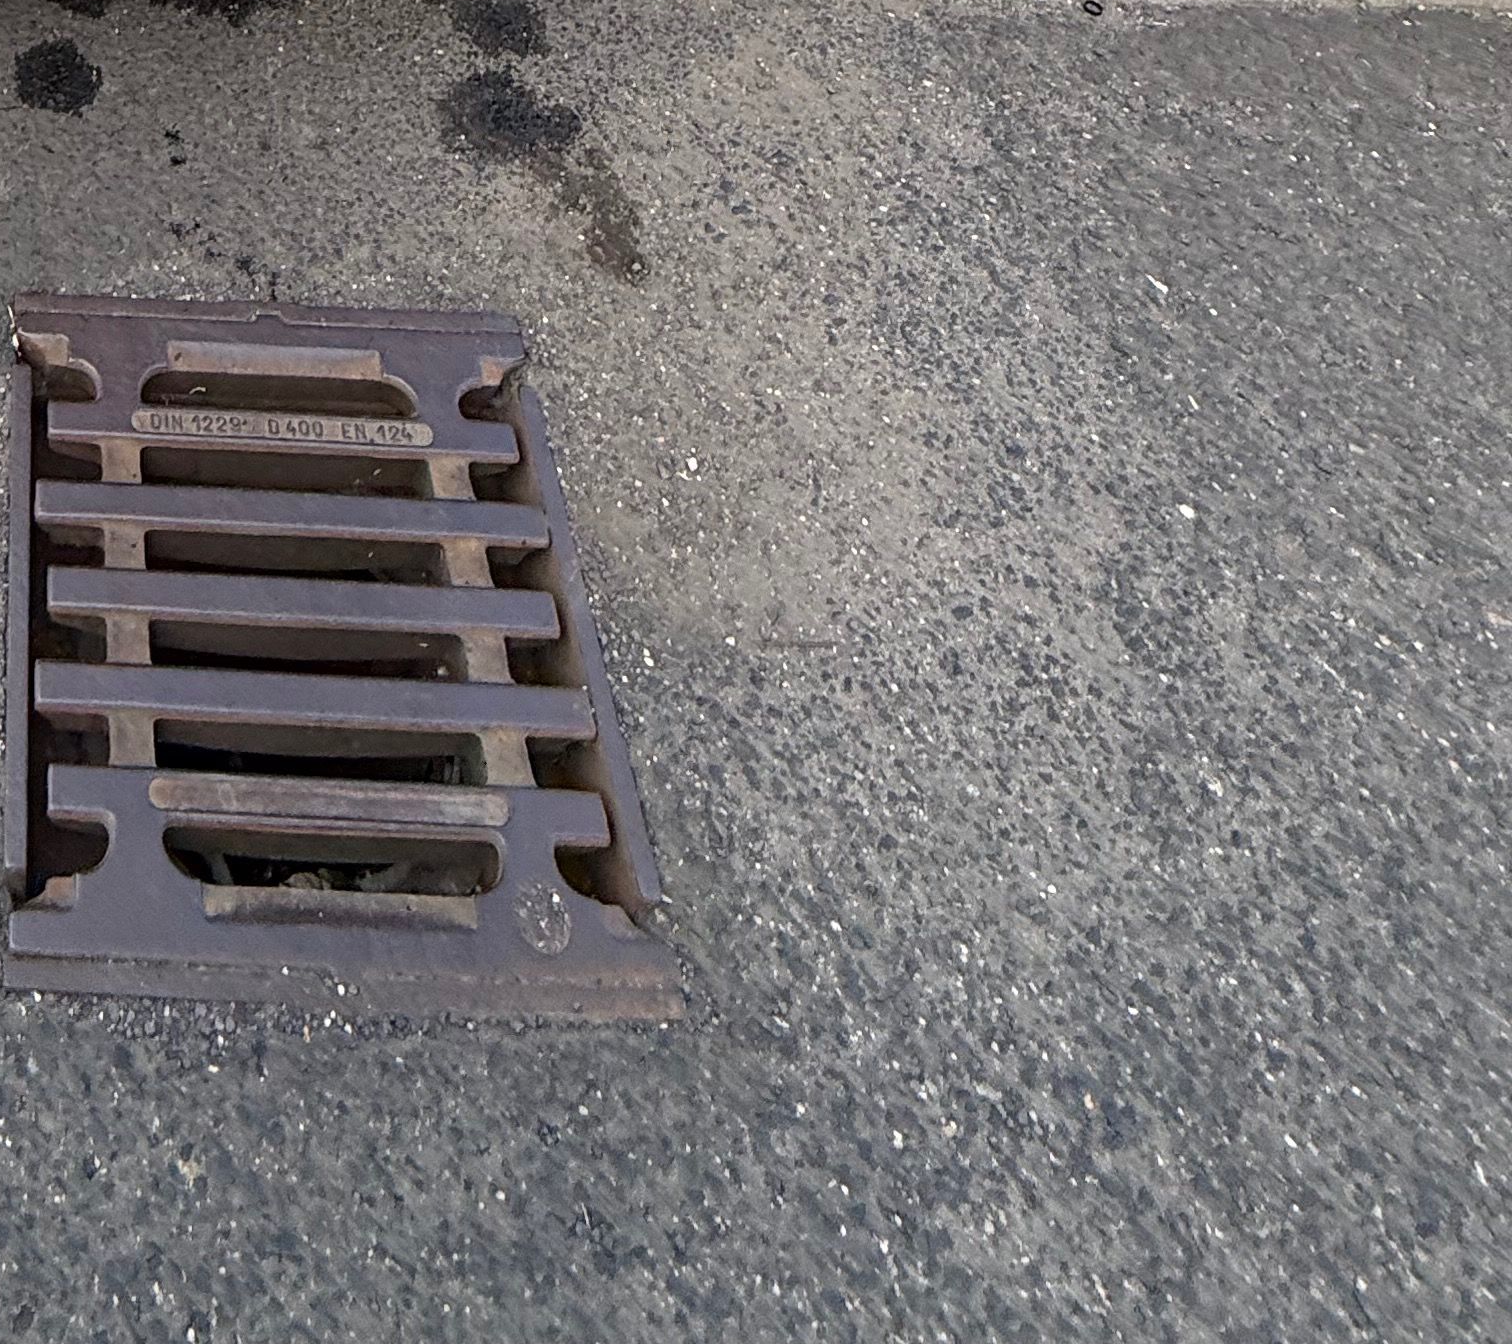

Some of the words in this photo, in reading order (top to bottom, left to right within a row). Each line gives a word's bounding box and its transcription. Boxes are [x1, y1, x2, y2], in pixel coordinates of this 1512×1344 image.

[150, 412, 183, 431] DIN
[287, 418, 324, 438] 400
[341, 421, 367, 440] EN
[376, 421, 414, 443] 124
